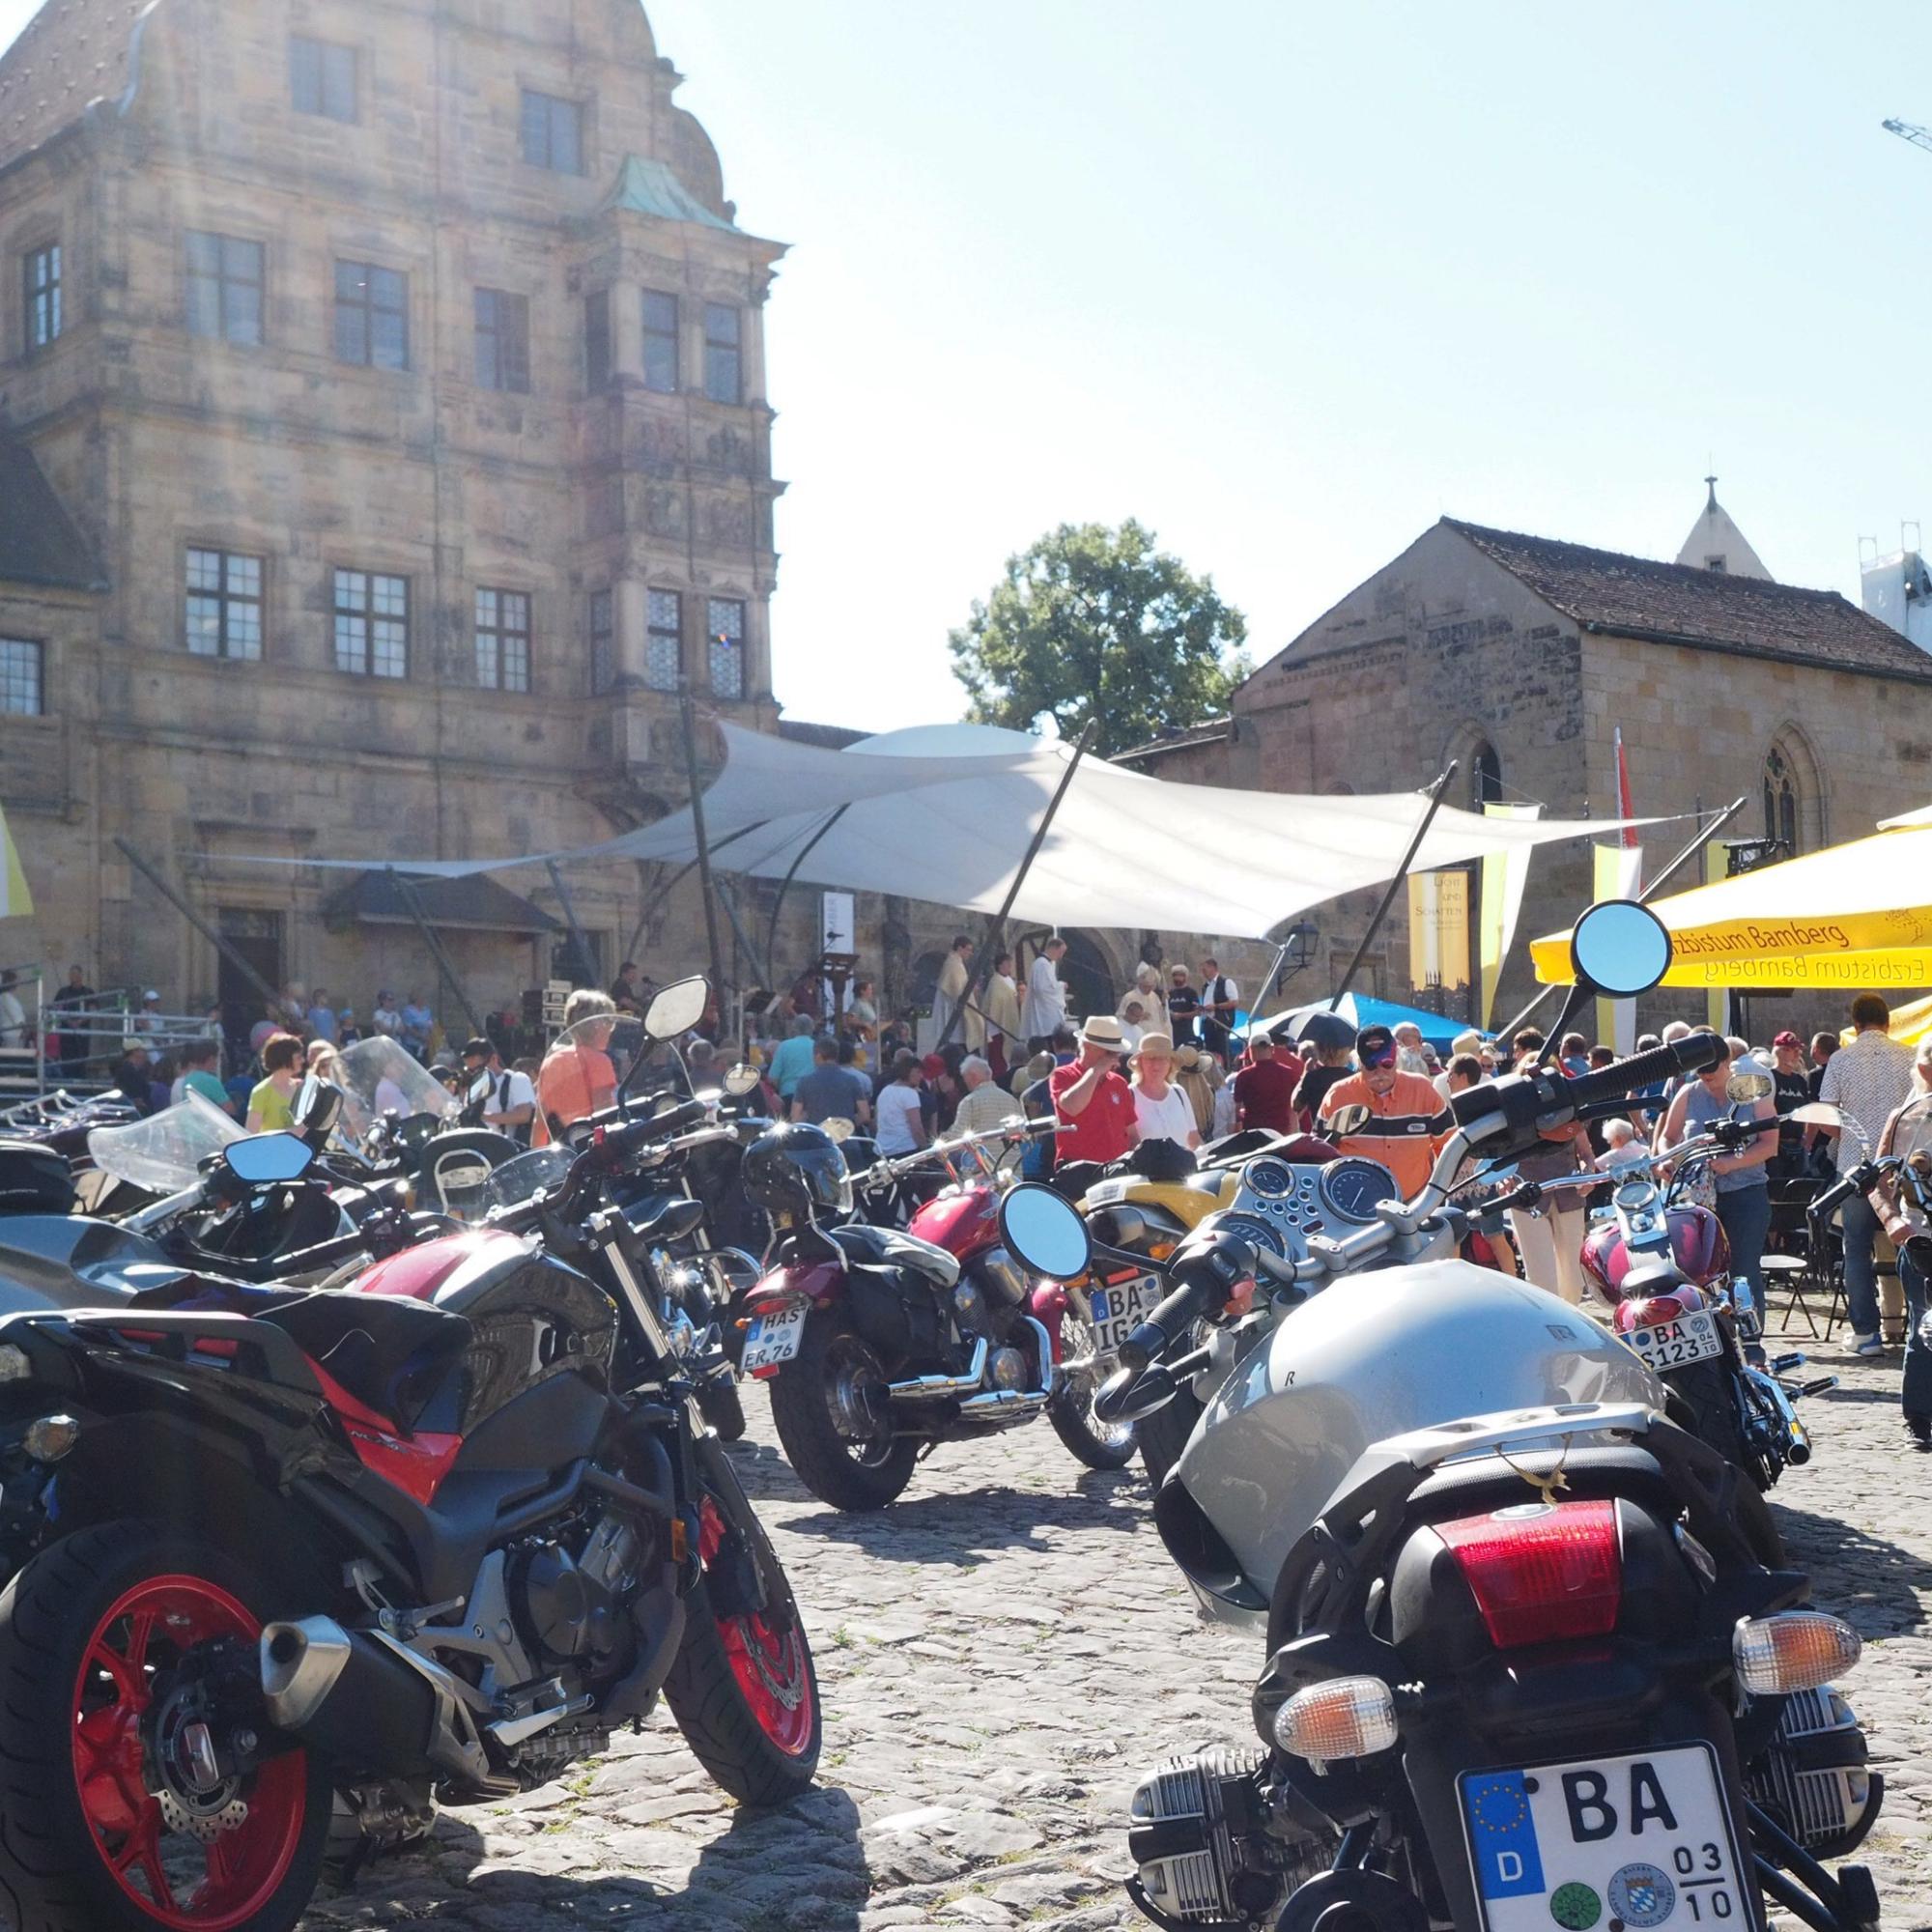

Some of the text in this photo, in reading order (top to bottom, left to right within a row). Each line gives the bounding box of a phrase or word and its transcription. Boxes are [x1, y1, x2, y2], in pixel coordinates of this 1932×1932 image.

[1747, 922, 1850, 949] Bamberg
[1108, 1285, 1143, 1317] BA
[764, 1308, 800, 1330] HAS
[1654, 1321, 1686, 1345] BA
[1284, 1371, 1295, 1387] R
[1561, 1762, 1678, 1843] BA
[1496, 1851, 1522, 1882] D
[1673, 1842, 1722, 1874] 03
[1686, 1889, 1732, 1921] 10
